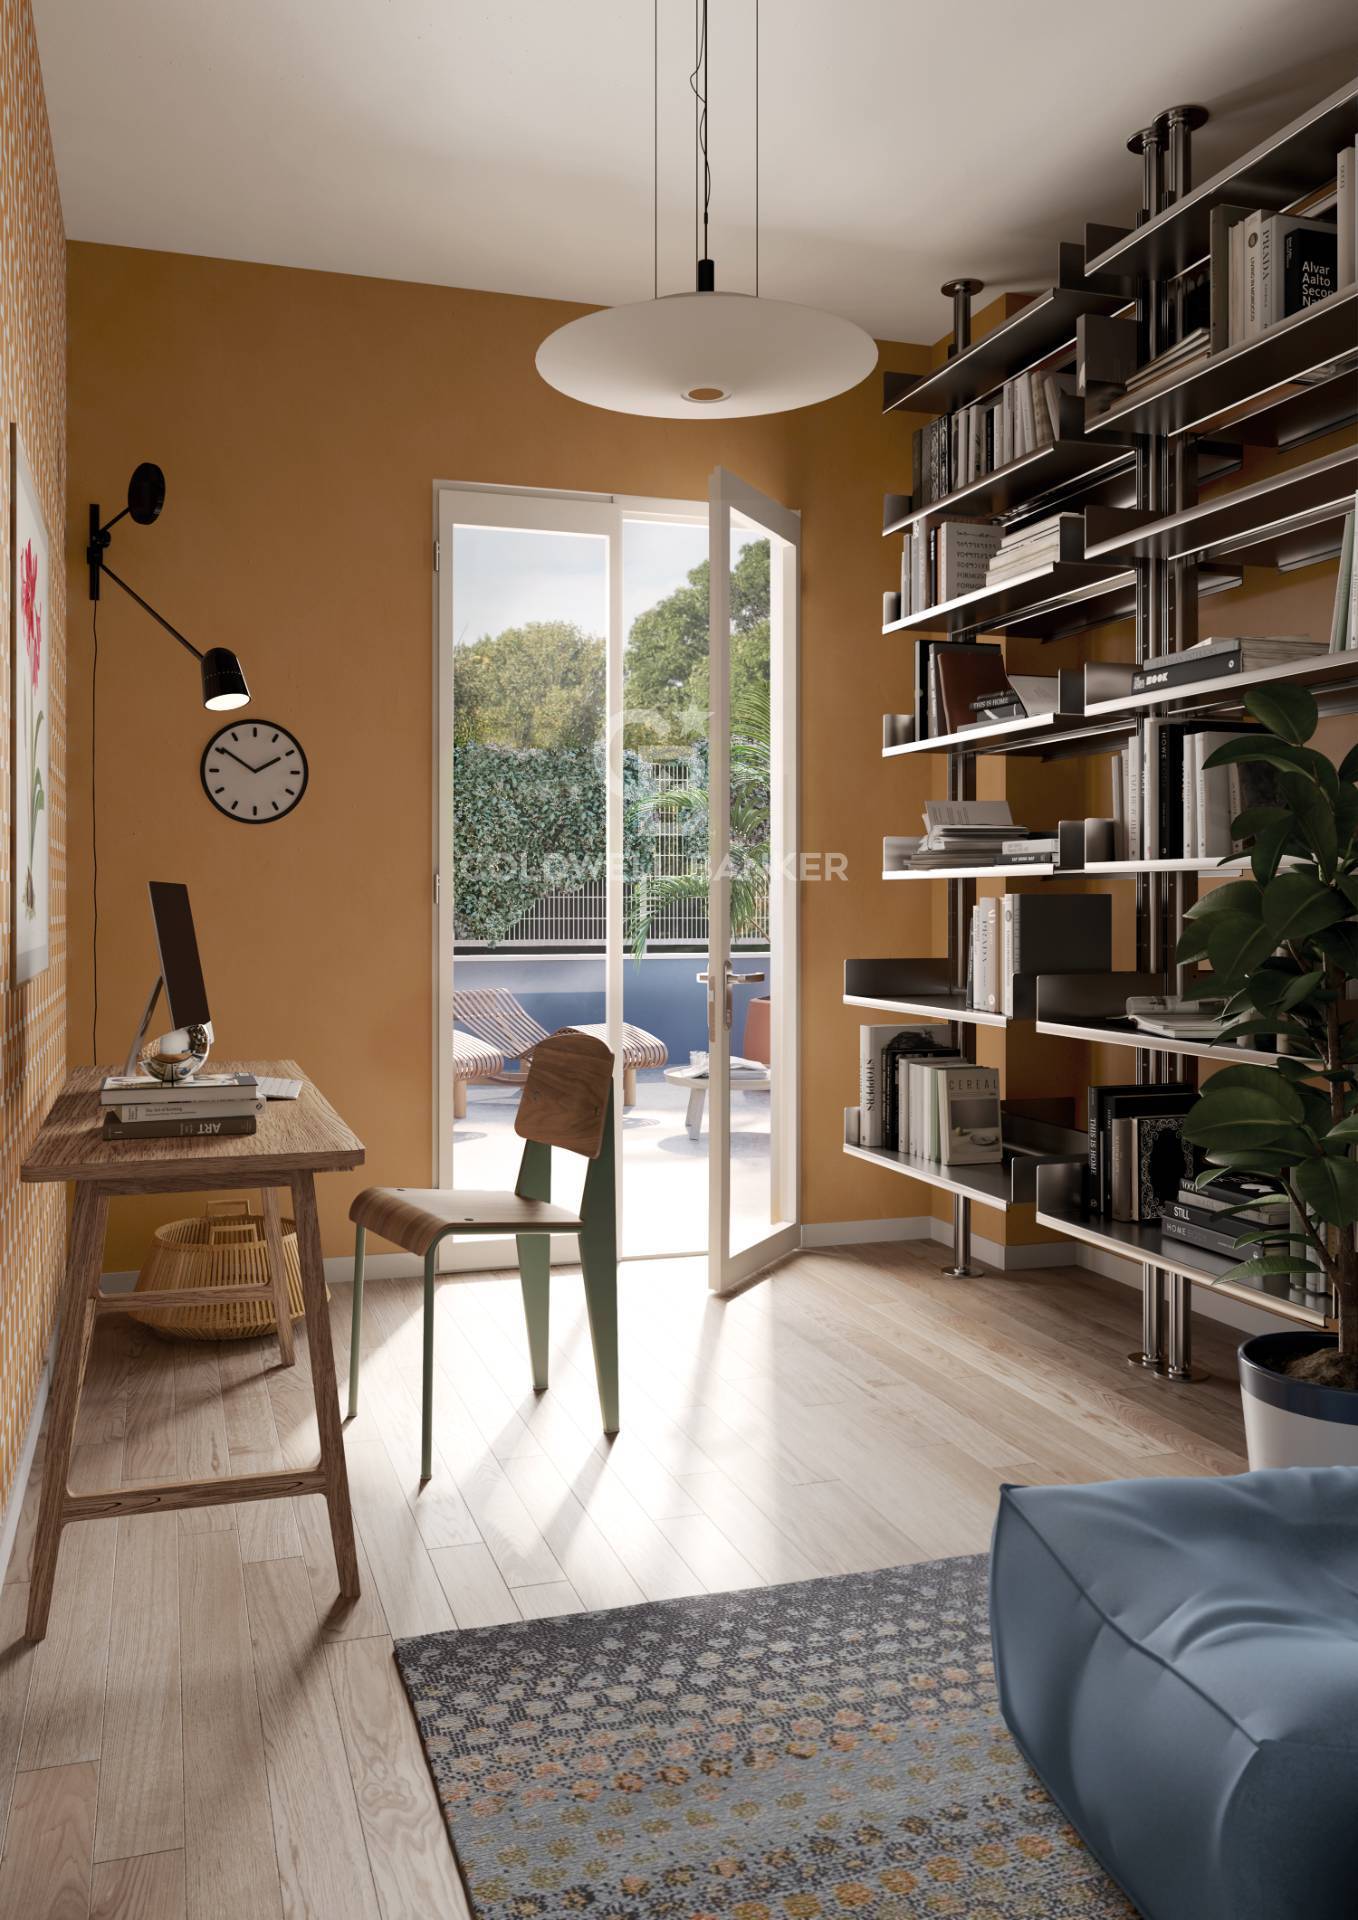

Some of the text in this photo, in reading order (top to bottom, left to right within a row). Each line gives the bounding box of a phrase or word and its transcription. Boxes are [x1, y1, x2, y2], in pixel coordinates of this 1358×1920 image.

[1262, 229, 1271, 281] PRADA
[1302, 260, 1330, 275] Alvar
[1302, 272, 1331, 287] Aalto
[1302, 284, 1334, 298] Secon
[949, 1079, 996, 1090] CEREAL
[197, 1122, 222, 1134] ART
[1089, 1117, 1097, 1176] THIS IS HOME
[1173, 1206, 1190, 1220] STILL
[1166, 1223, 1187, 1236] HOME
